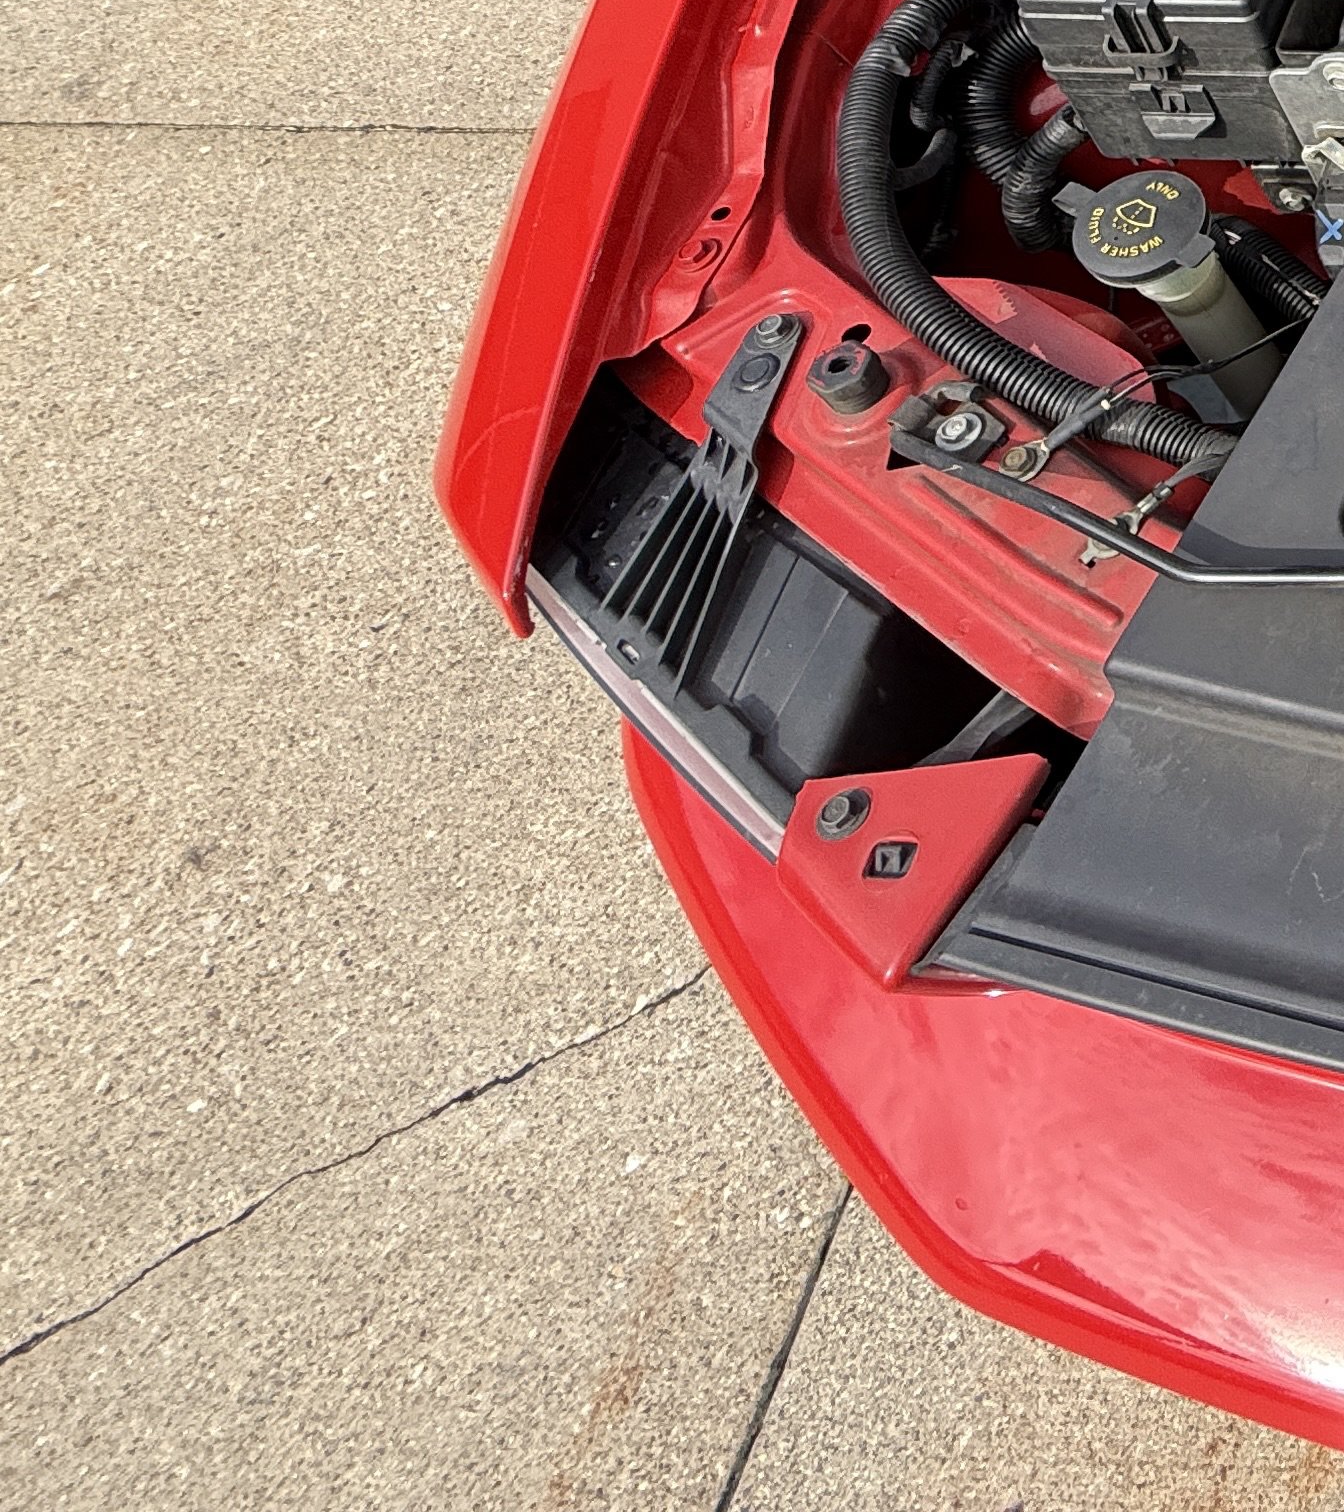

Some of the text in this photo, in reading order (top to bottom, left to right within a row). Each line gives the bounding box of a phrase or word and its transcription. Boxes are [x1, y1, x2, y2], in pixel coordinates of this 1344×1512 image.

[1145, 181, 1180, 200] ONLY
[1087, 207, 1164, 257] WASHER FLUID
